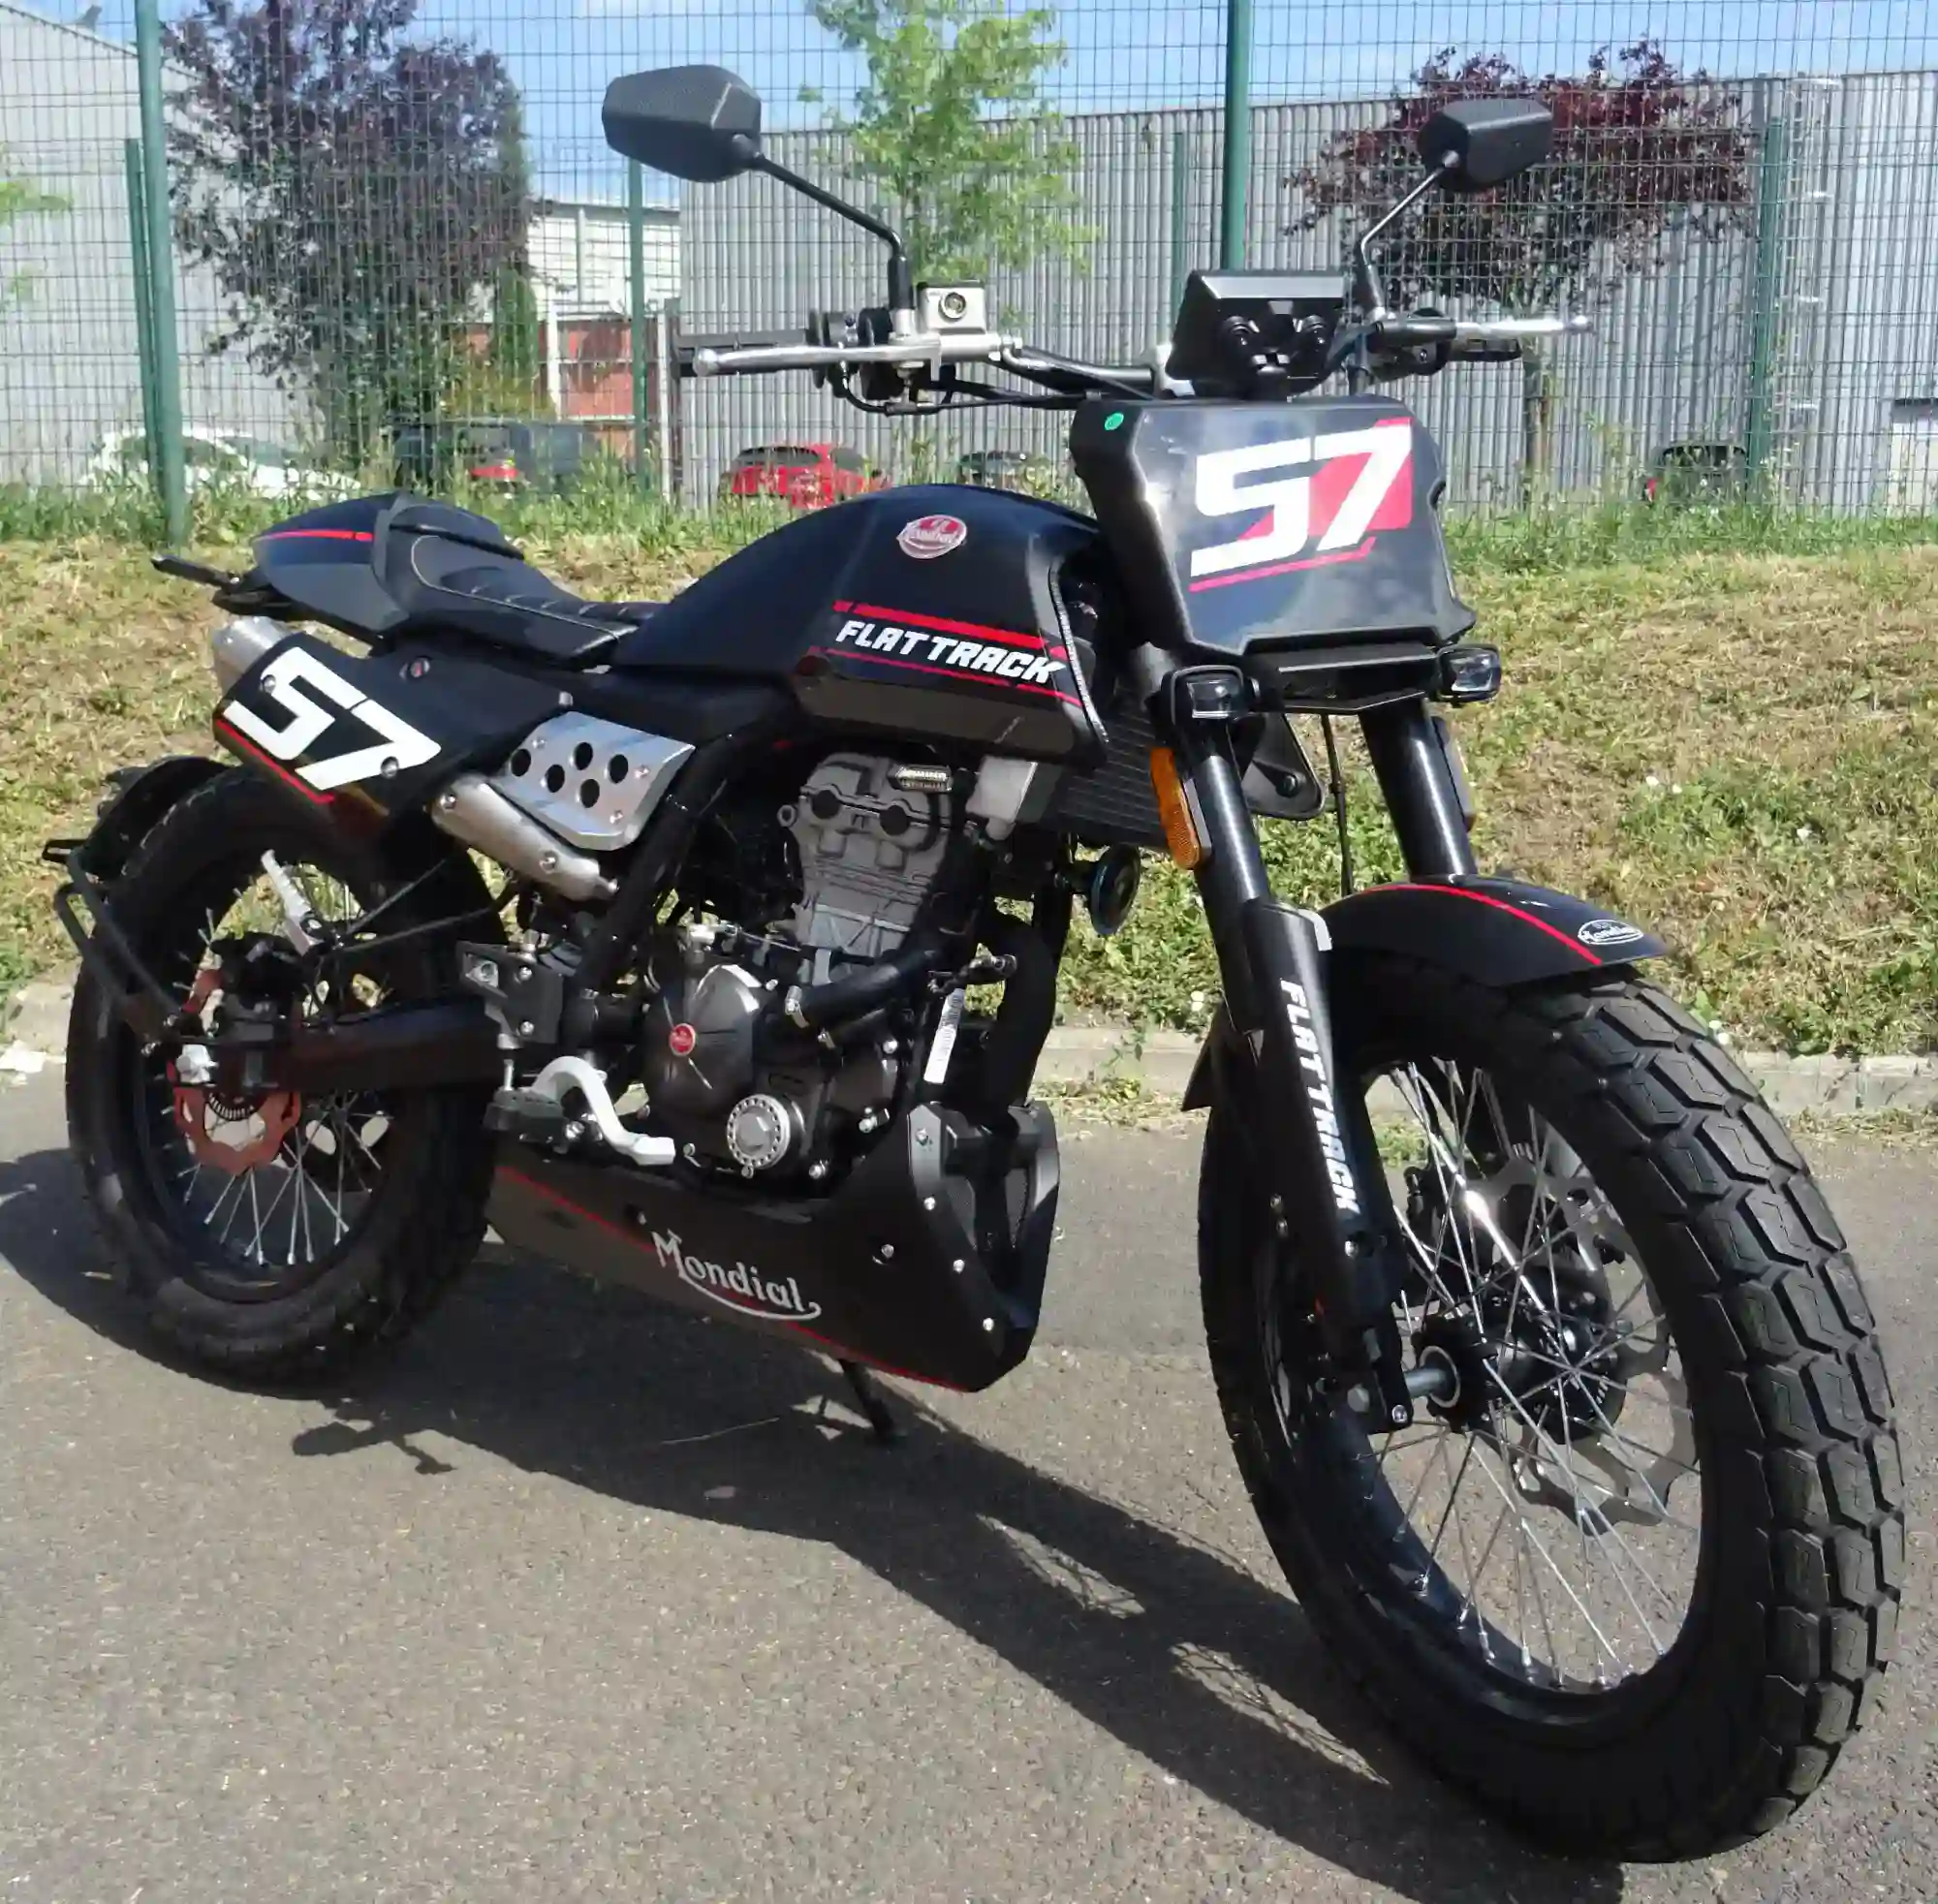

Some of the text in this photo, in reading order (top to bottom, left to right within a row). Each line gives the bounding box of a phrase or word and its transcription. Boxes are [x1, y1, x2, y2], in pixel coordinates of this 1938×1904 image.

[1190, 423, 1412, 578] 57
[222, 646, 442, 791] 57
[835, 619, 1067, 684] FLAT TRACK
[1279, 979, 1361, 1215] FLAT TRACK
[651, 1228, 822, 1321] Mondial
